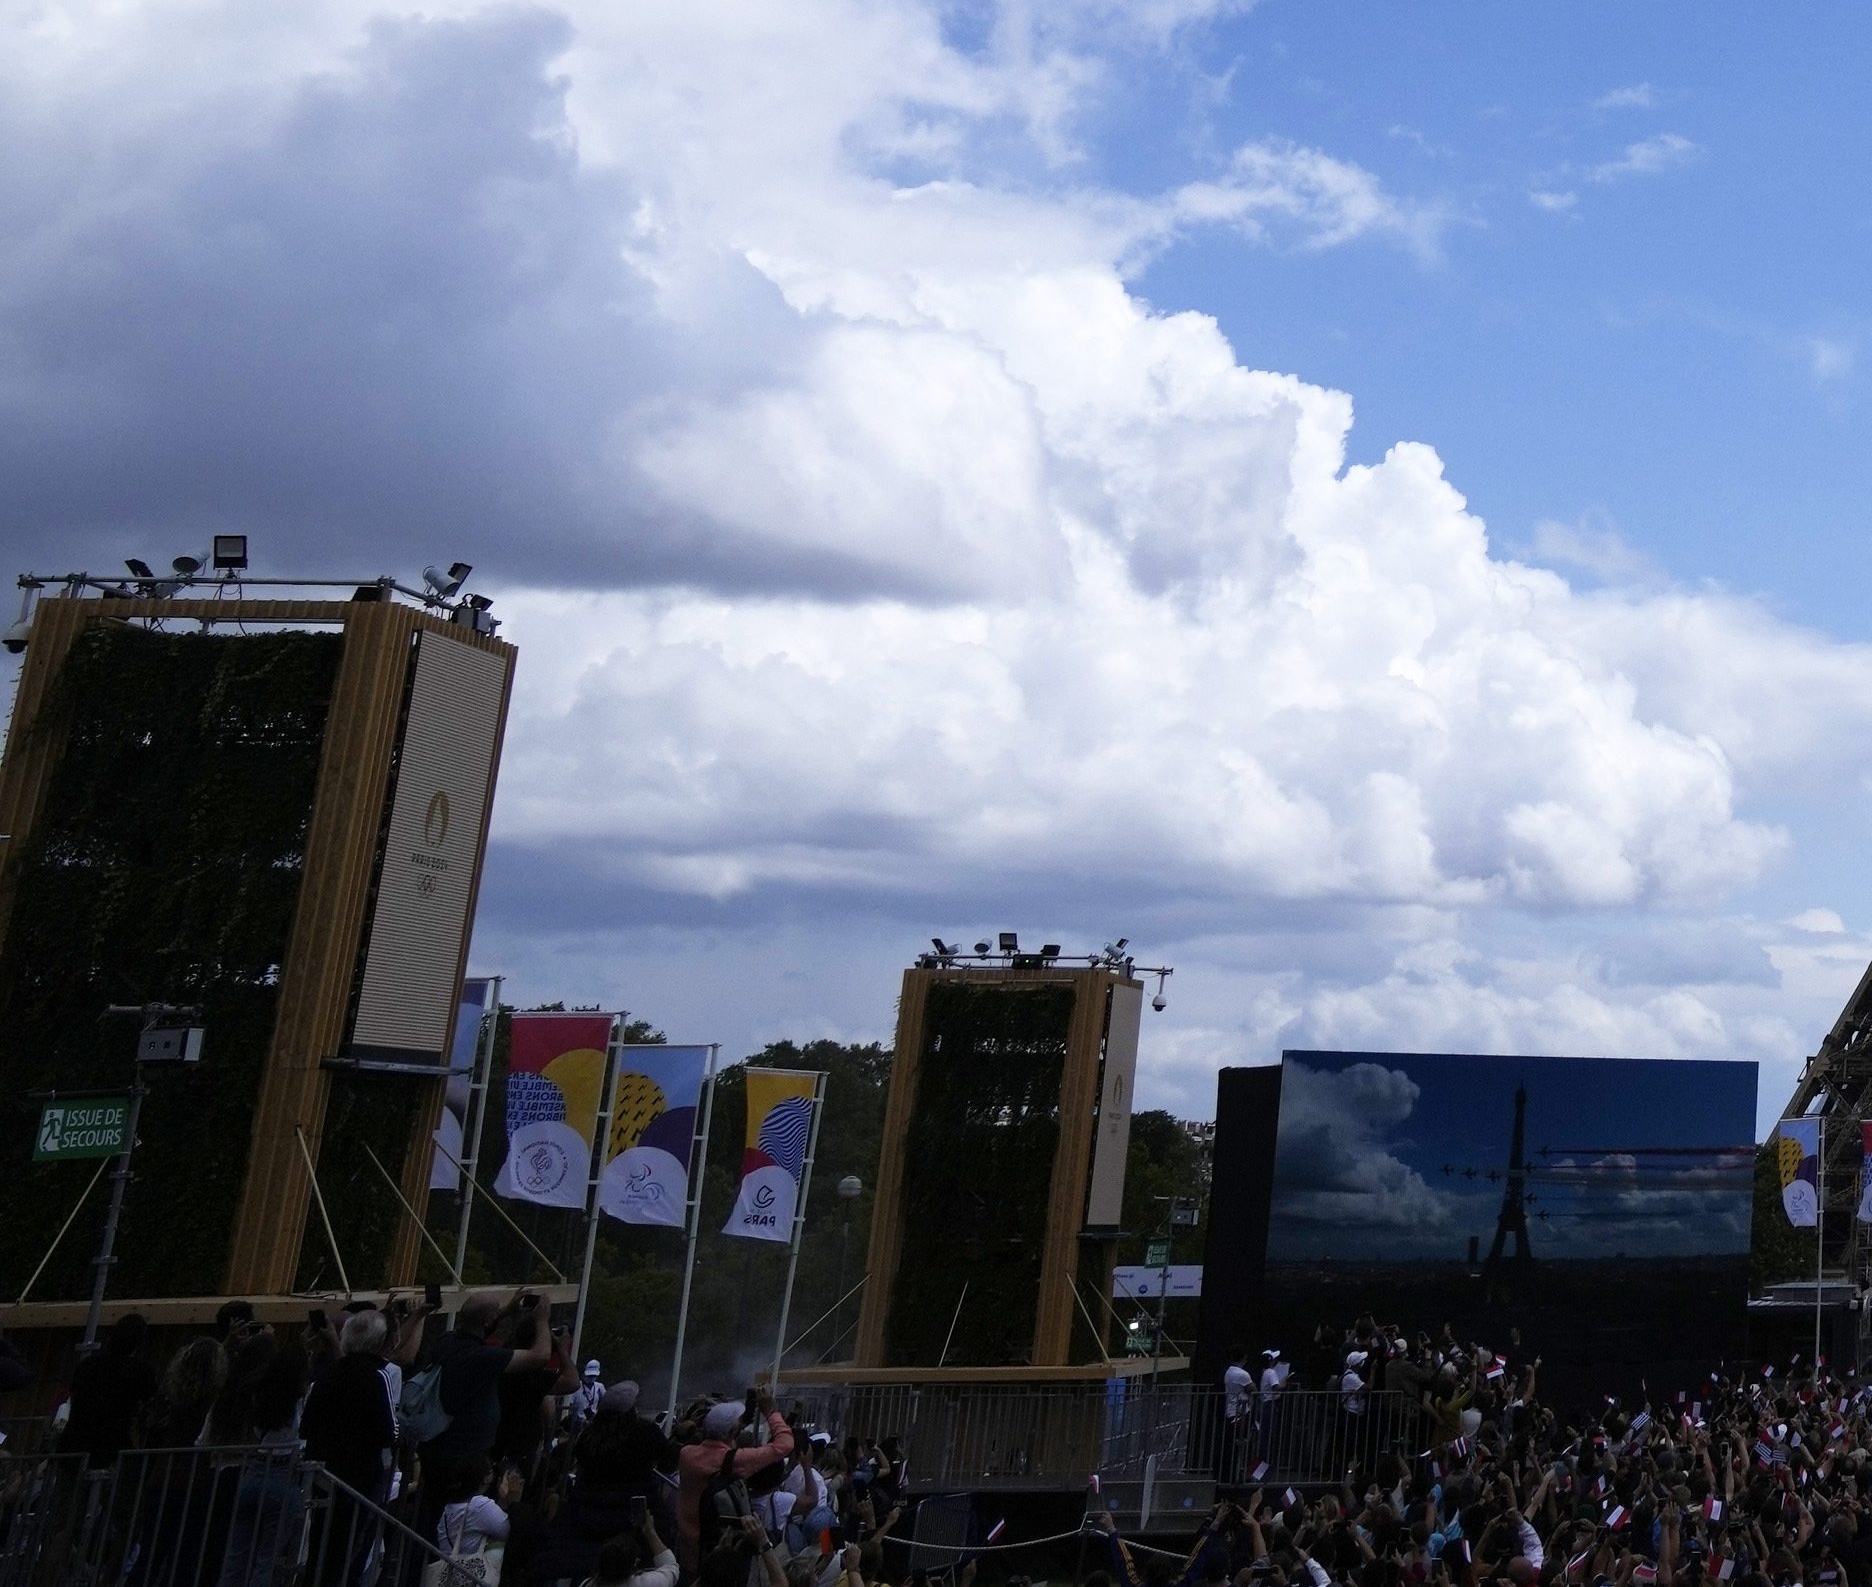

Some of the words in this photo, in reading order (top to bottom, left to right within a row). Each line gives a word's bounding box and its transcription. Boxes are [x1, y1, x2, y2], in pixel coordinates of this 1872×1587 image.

[66, 1109, 104, 1127] ISSUE
[105, 1108, 124, 1125] DE
[61, 1129, 122, 1148] SECOURS
